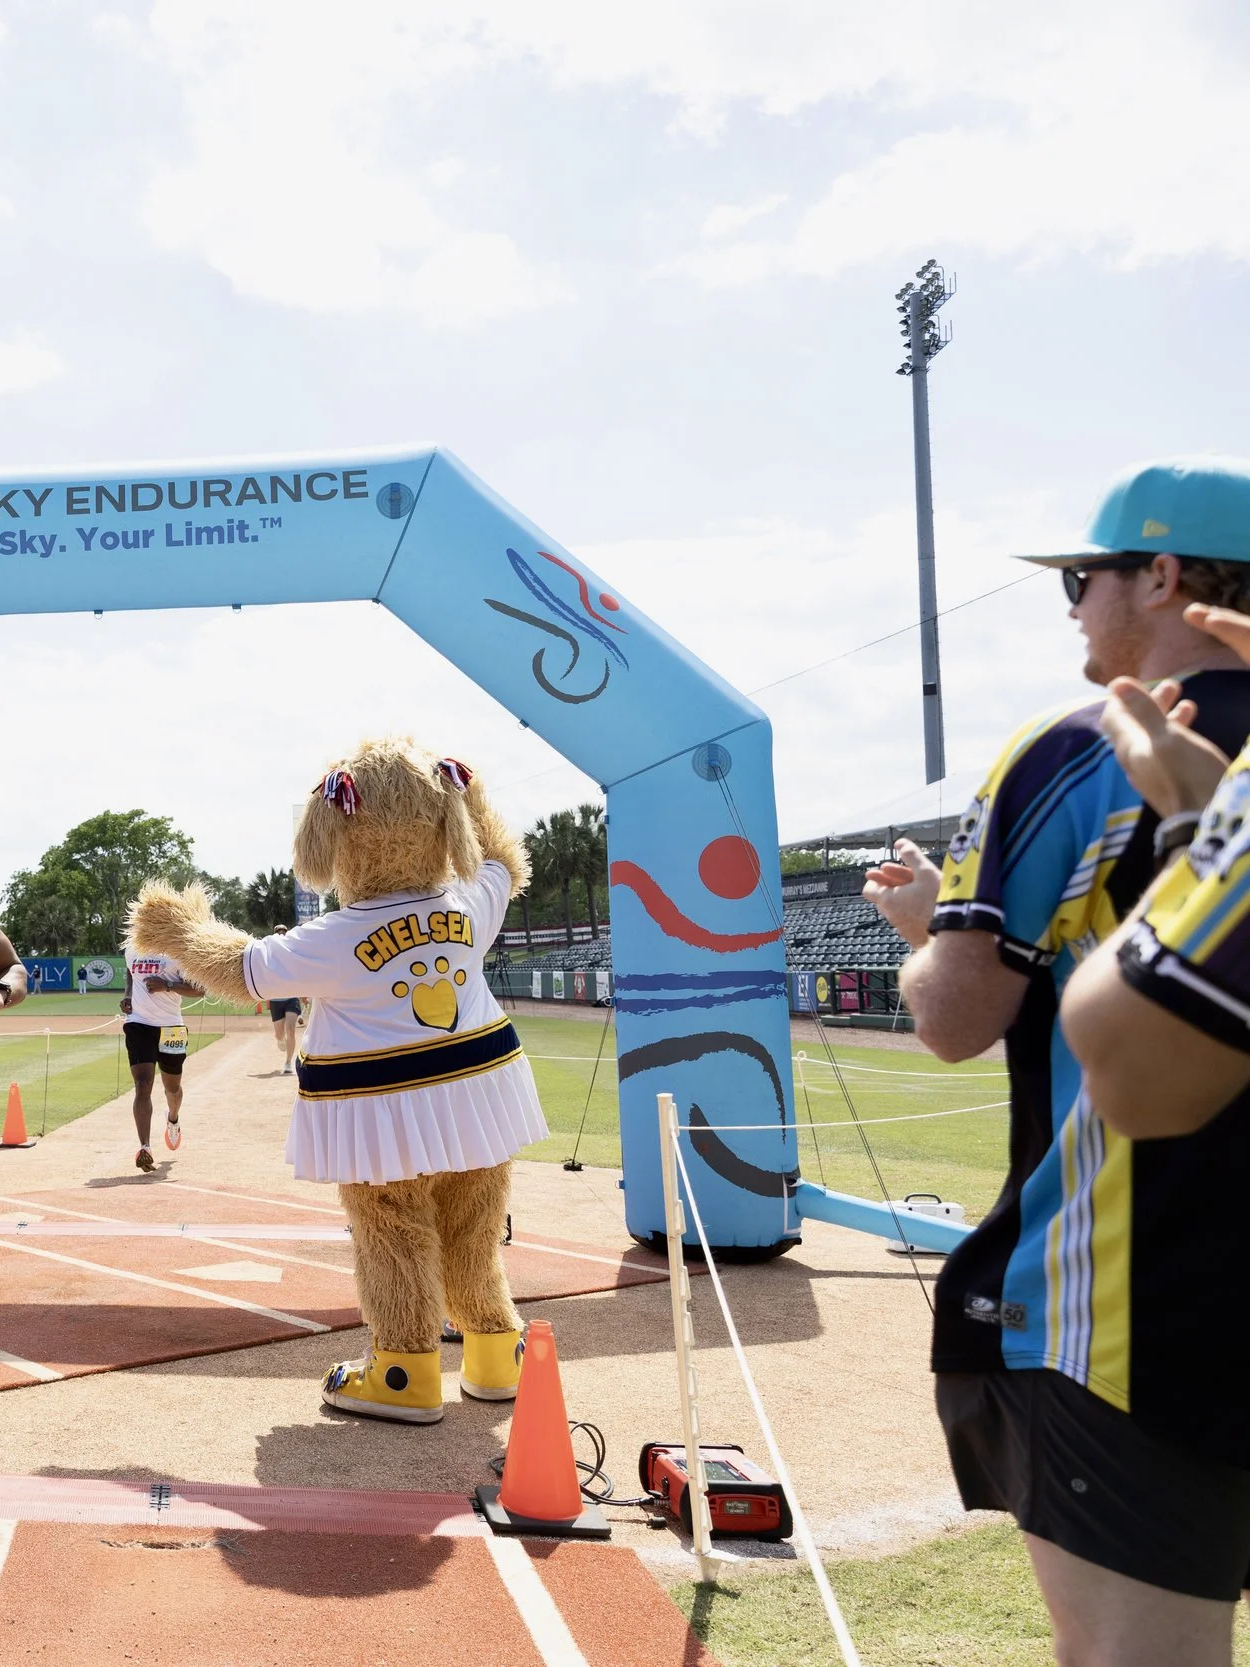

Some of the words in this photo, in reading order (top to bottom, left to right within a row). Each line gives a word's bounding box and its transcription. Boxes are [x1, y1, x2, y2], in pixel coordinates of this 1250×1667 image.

[66, 469, 369, 515] ENDURANCE
[76, 526, 155, 551] Your
[354, 910, 473, 972] CHELSEA
[164, 1039, 184, 1049] 4095
